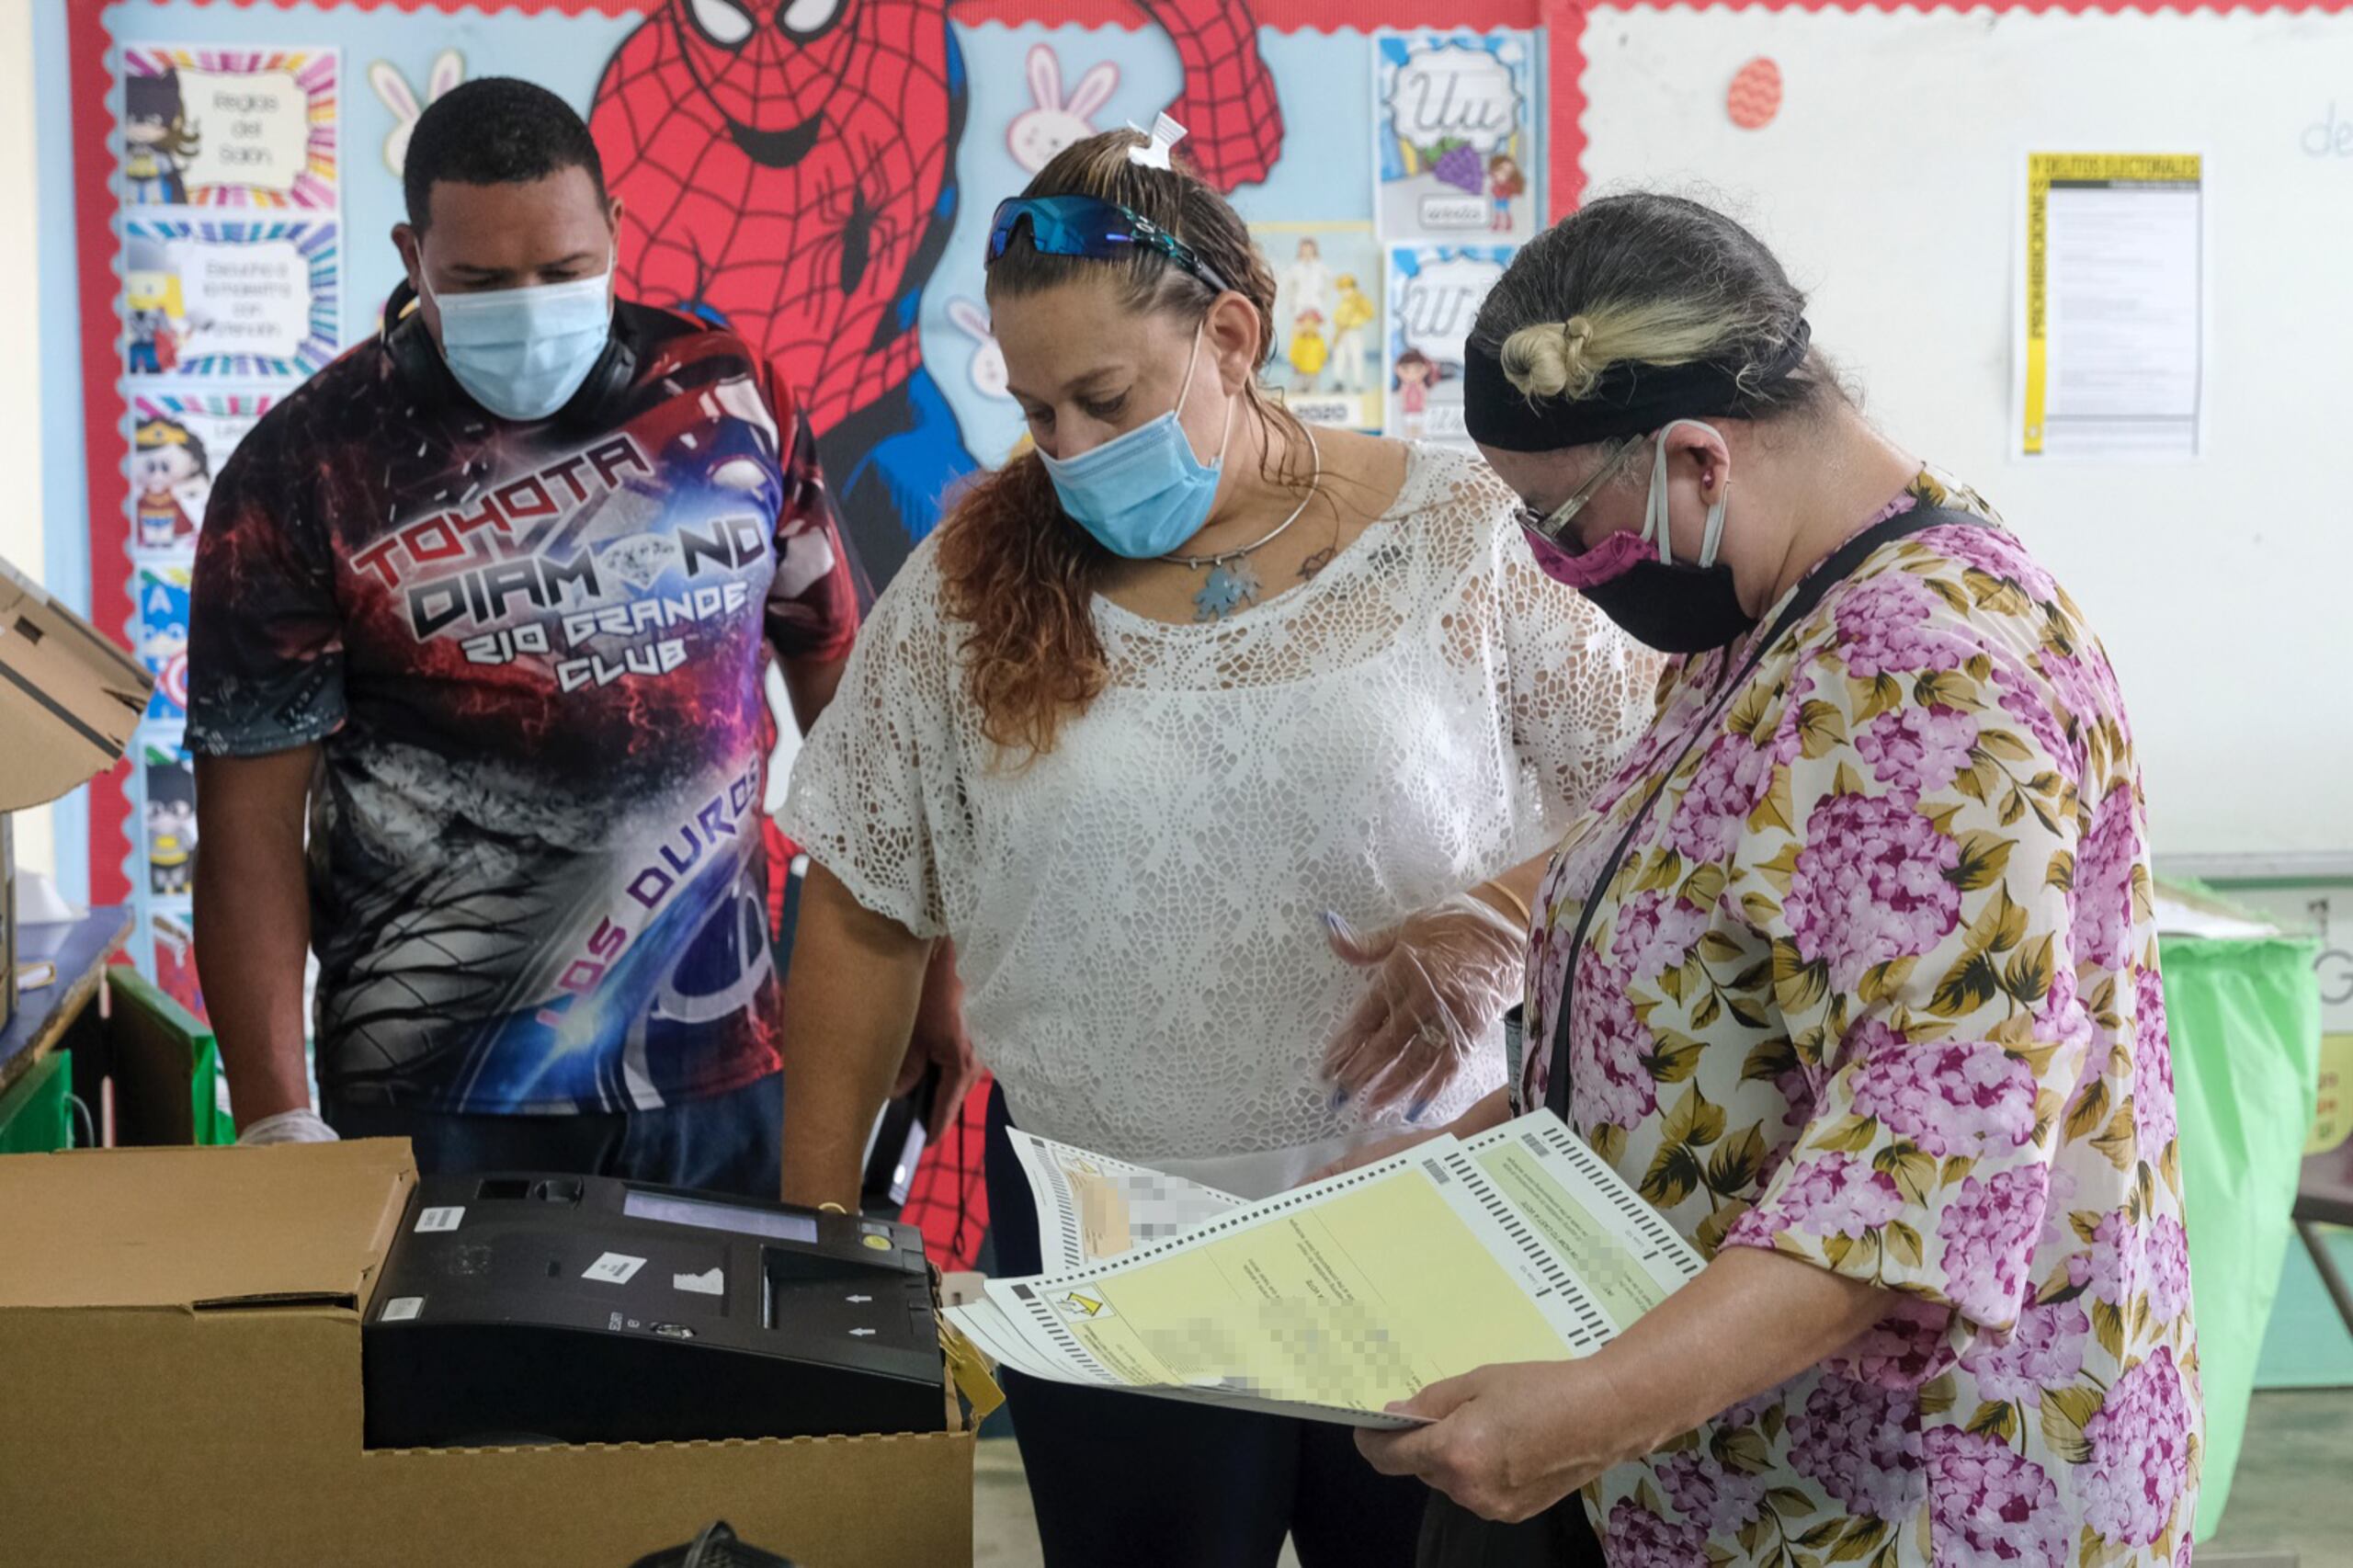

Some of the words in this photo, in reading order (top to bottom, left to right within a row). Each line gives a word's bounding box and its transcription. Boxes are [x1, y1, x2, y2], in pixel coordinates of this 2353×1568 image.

[350, 432, 655, 591] TOYOTA
[460, 622, 550, 666] RIO
[562, 581, 750, 646] GRANDE
[555, 640, 688, 695] CLUB
[535, 915, 629, 1030] LOS
